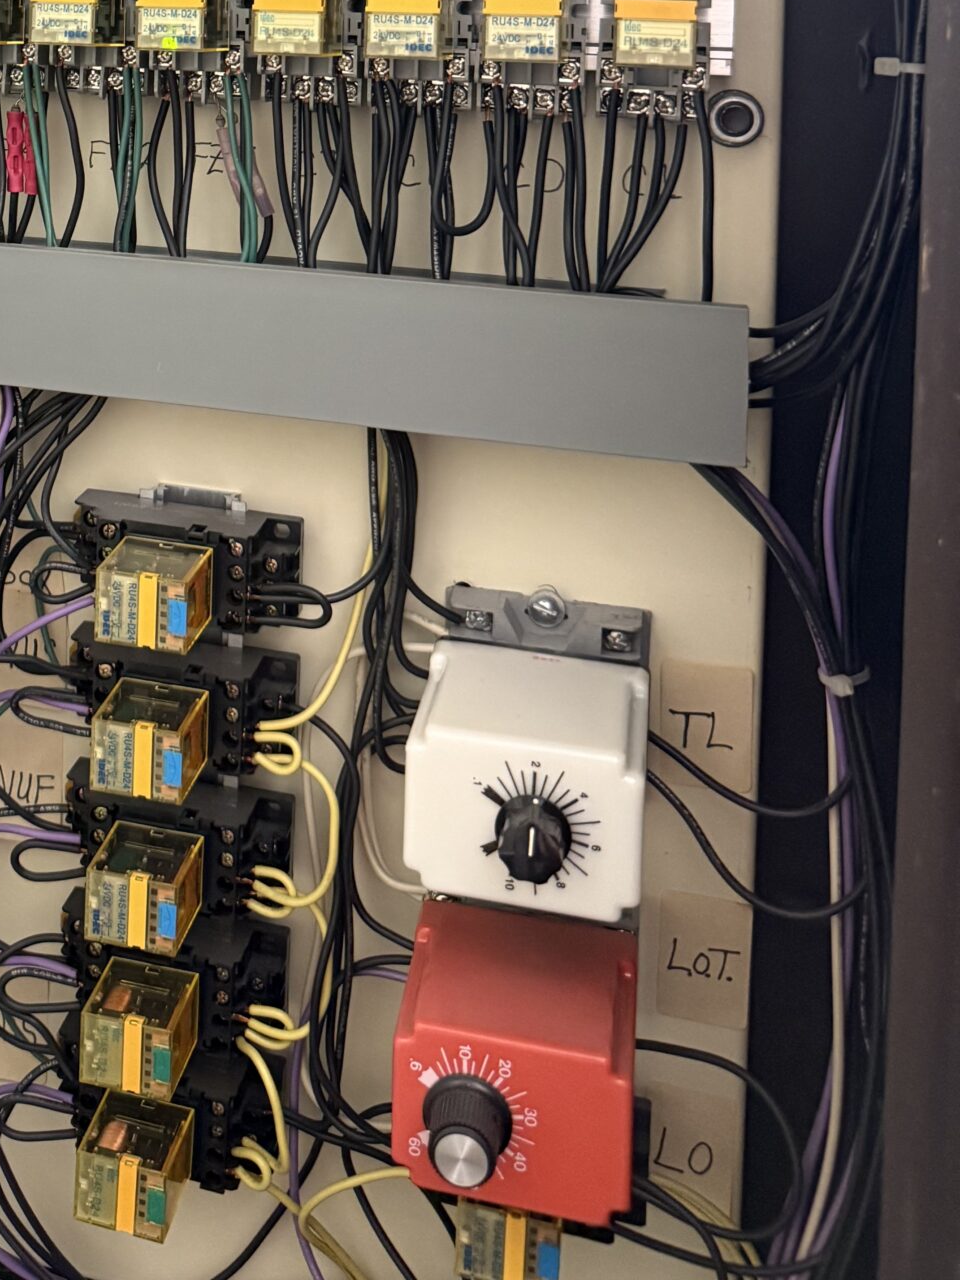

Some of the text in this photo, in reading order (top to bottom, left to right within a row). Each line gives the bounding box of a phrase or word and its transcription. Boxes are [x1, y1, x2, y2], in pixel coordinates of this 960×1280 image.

[373, 15, 433, 25] RU4S-M-D24
[491, 16, 555, 27] RU4S-M-D24
[405, 43, 432, 52] IDEC
[525, 46, 554, 55] IDEC
[580, 792, 588, 800] 4
[591, 844, 601, 852] 6
[505, 879, 514, 891] 10
[556, 881, 565, 889] 8
[459, 1045, 471, 1059] 10
[498, 1059, 512, 1078] 20
[524, 1108, 538, 1127] 30
[409, 1137, 421, 1156] 60
[654, 1127, 713, 1175] LO
[514, 1152, 526, 1172] 40
